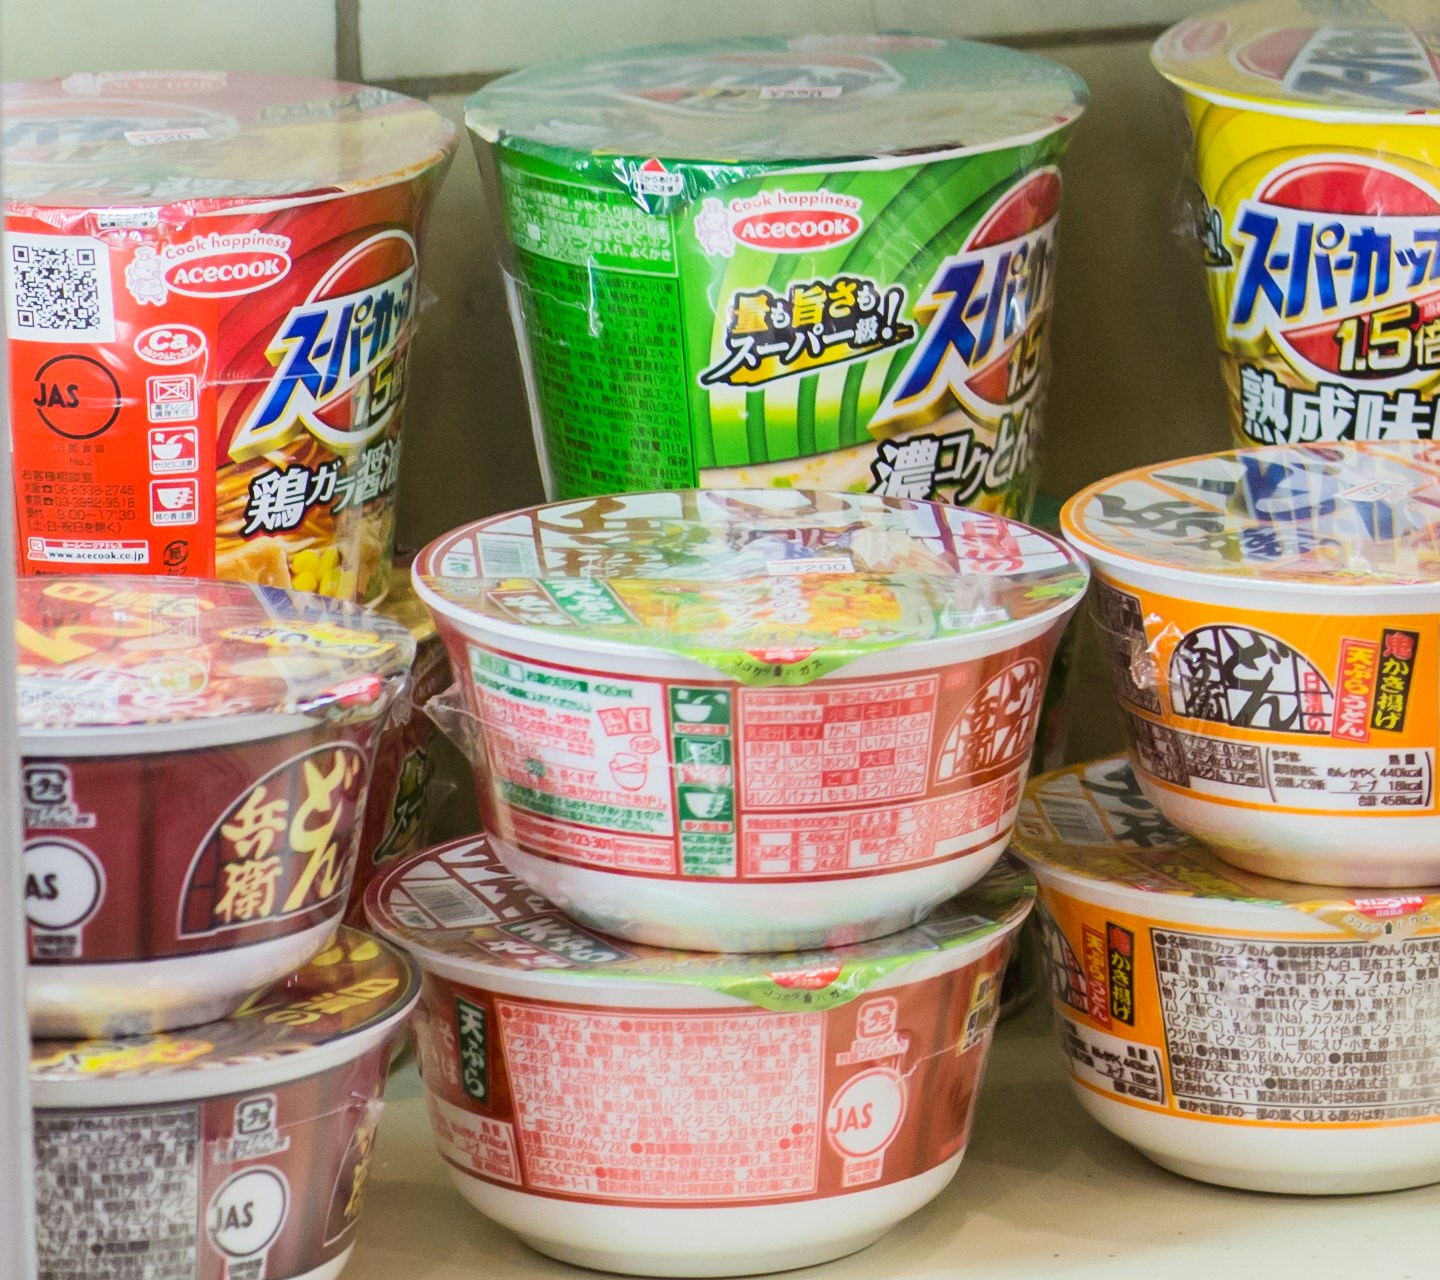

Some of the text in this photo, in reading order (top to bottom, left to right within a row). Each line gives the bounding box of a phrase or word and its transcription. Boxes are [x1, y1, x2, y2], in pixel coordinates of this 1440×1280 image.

[776, 190, 860, 212] happiness
[210, 233, 288, 250] happiness
[732, 283, 876, 337] 量も旨さも
[148, 330, 189, 349] Ca
[33, 382, 80, 408] JAS
[48, 550, 145, 563] www.acecook.co.jp
[1340, 644, 1377, 738] 天ぷらうどん
[827, 1104, 874, 1138] JAS
[213, 1201, 255, 1235] JAS
